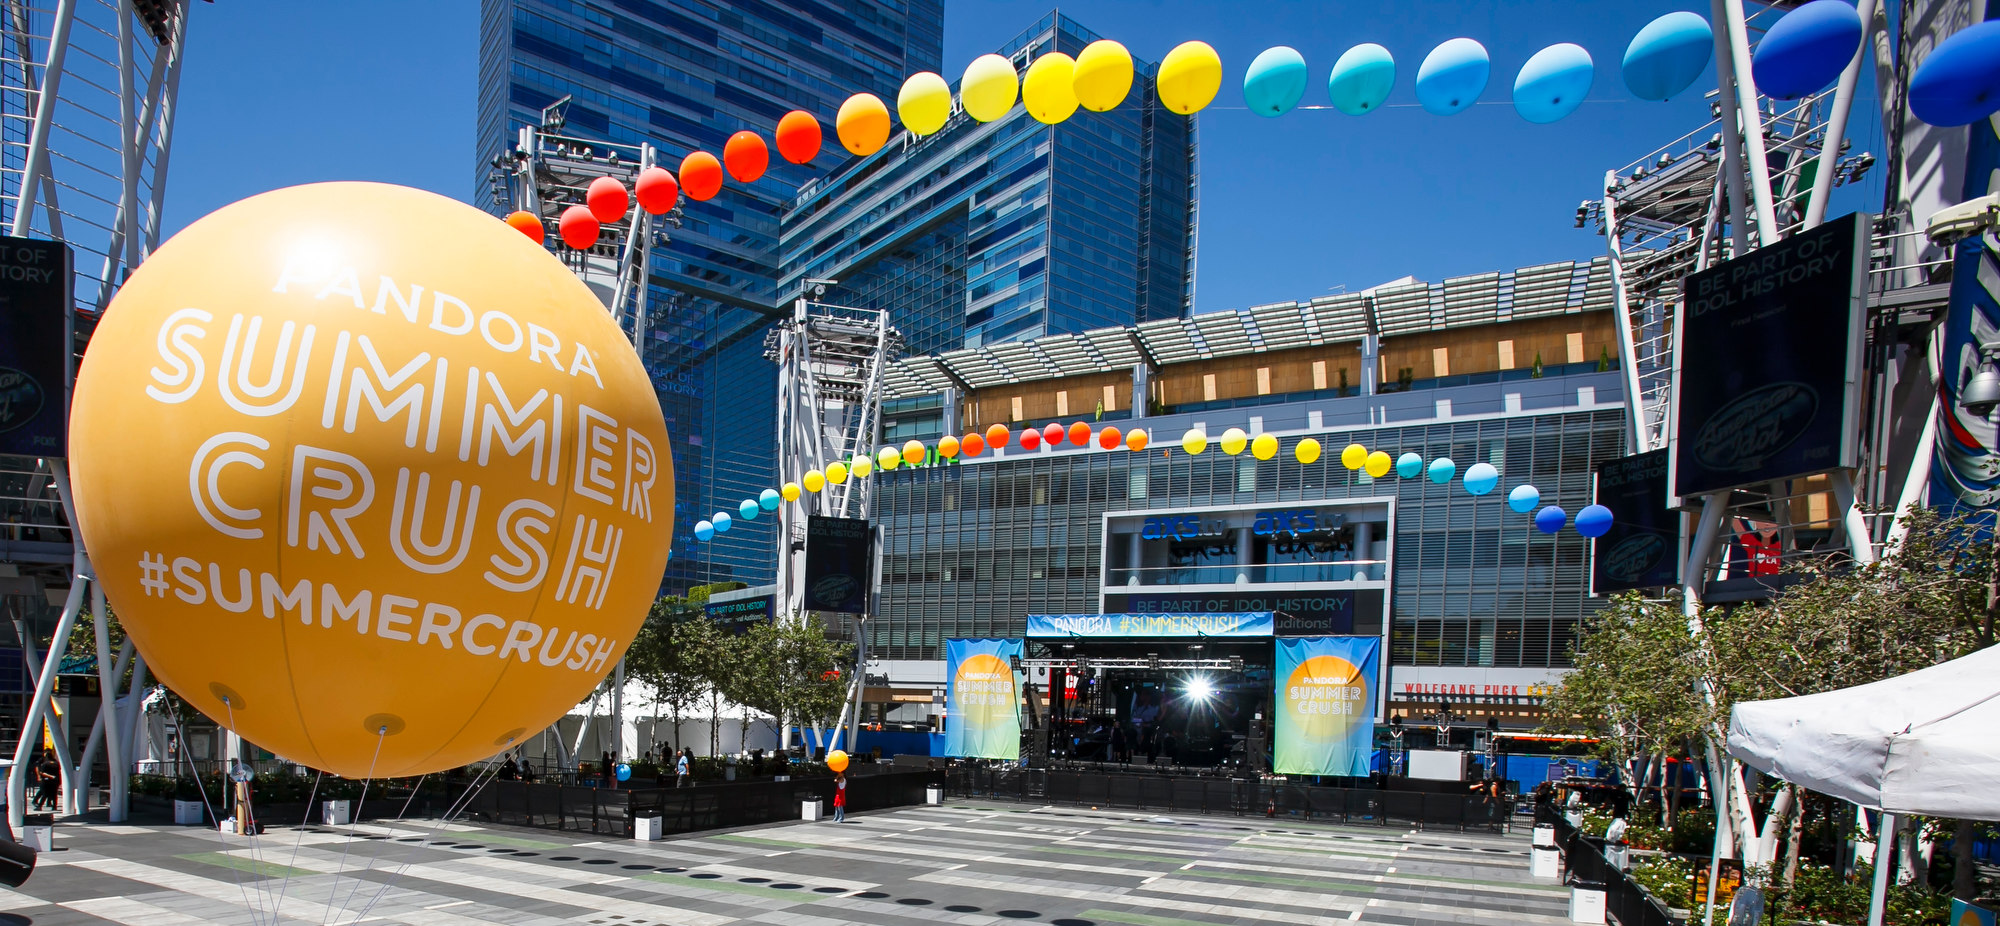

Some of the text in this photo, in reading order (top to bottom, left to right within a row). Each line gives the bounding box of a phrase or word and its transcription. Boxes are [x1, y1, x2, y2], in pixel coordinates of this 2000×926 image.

[16, 247, 47, 264] OF
[1698, 232, 1834, 297] BE PART OF
[1689, 250, 1841, 319] IDOL HISTORY
[272, 256, 604, 390] PANDORA
[145, 307, 656, 524] SUMMER
[1728, 413, 1785, 465] Idol
[1604, 464, 1619, 477] BE
[1622, 456, 1652, 473] PART
[1600, 465, 1667, 489] IDOL HISTOR
[188, 431, 624, 610] CRUSH
[813, 520, 863, 530] BE PART OF
[810, 527, 865, 538] IDOL HISTORY
[138, 550, 617, 673] #SUMMERCRUSH
[735, 603, 747, 611] IDOL
[747, 600, 767, 611] HISTORY
[1137, 598, 1348, 613] BE PART OF IDOL HISTORY
[1054, 615, 1239, 634] PANDORA #SUMMERCRUSH
[1275, 617, 1332, 629] uditions!
[965, 672, 1001, 680] PANDORA
[1303, 677, 1349, 686] PANDORA
[957, 681, 1013, 694] SUMMER
[1290, 686, 1361, 700] SUMMER
[1405, 683, 1476, 695] WOLFGANG
[1484, 685, 1519, 696] PUCK
[962, 693, 1006, 706] CRUSH
[1297, 701, 1353, 715] CRUSH
